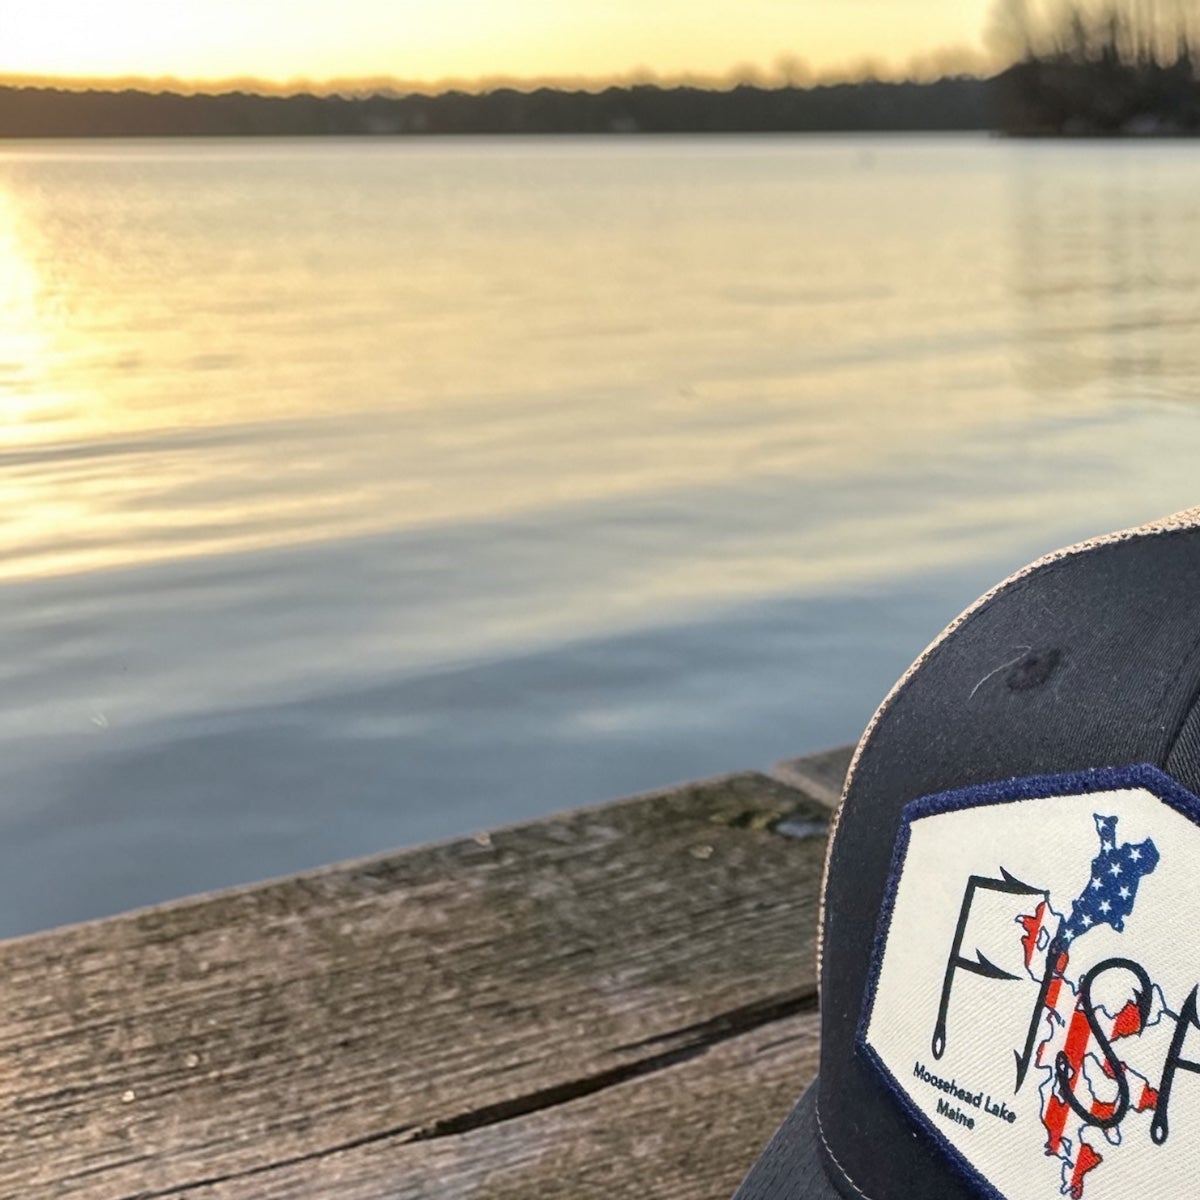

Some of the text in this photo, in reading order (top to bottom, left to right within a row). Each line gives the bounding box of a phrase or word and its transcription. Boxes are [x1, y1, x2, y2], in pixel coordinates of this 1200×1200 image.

[913, 1061, 1017, 1124] Moosehead Lake
[936, 1098, 975, 1130] Maine
